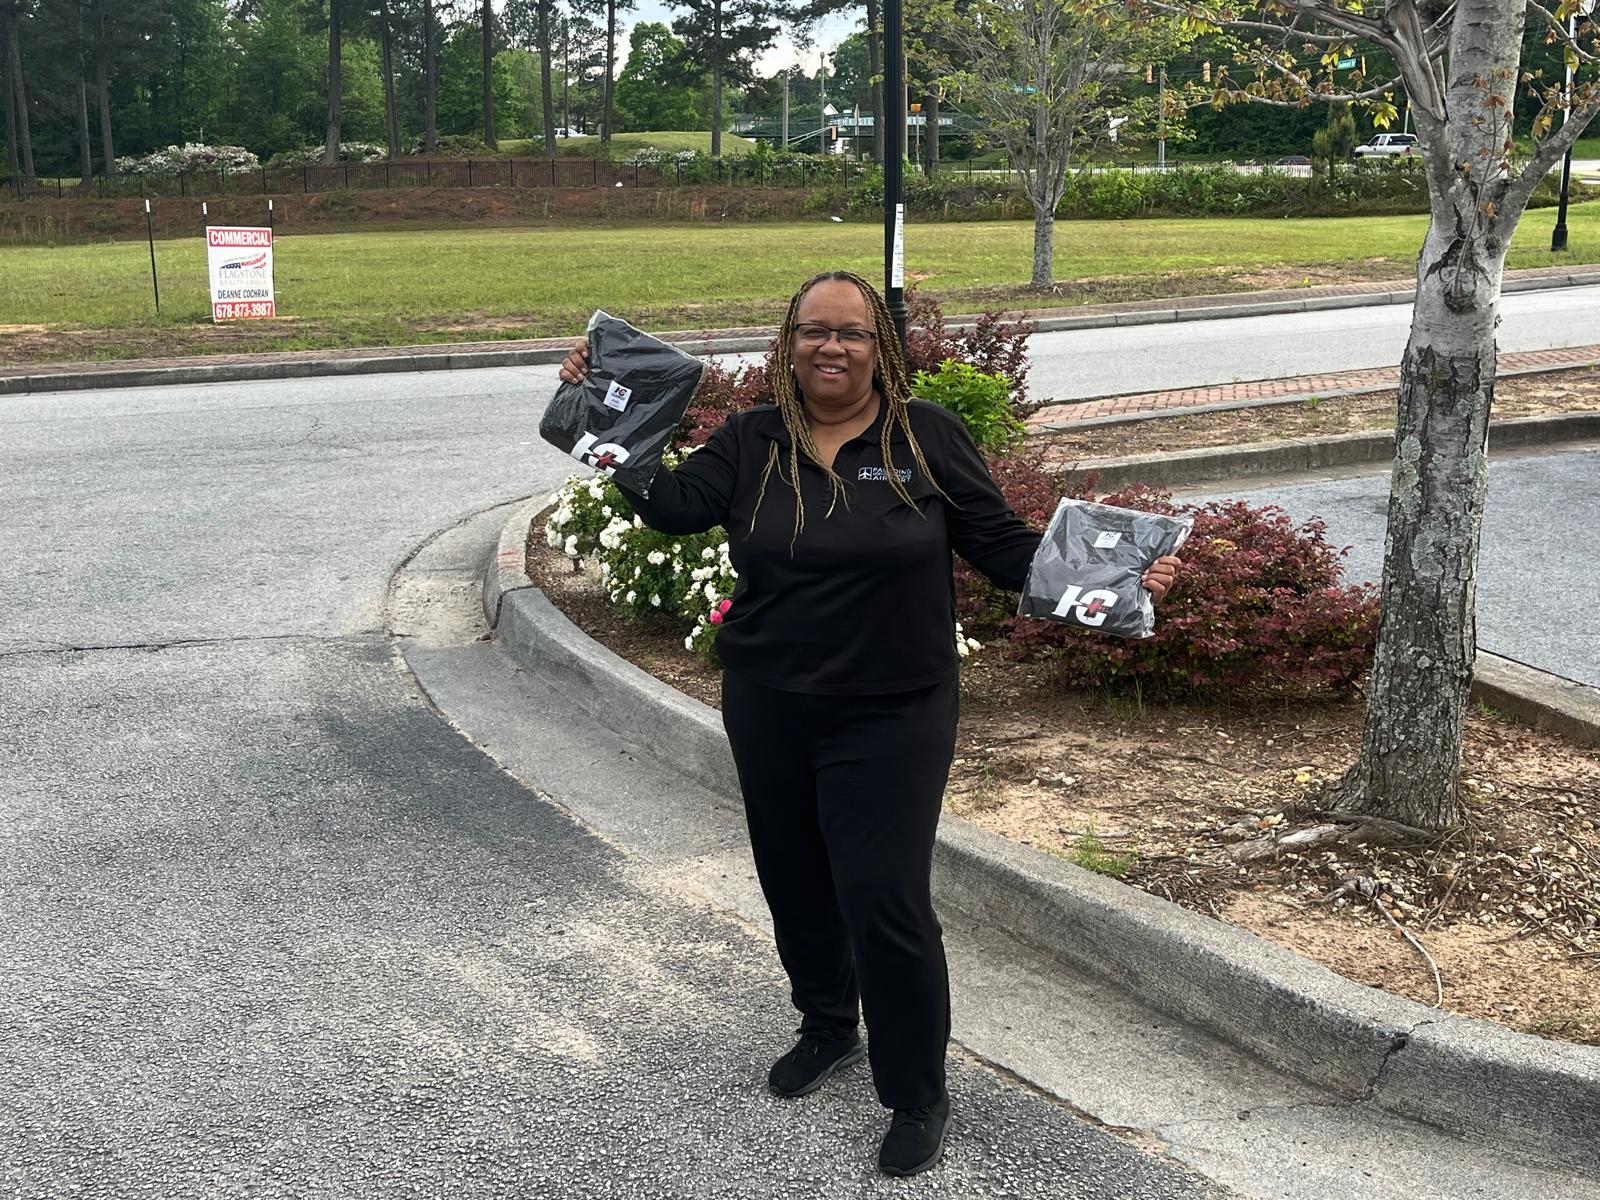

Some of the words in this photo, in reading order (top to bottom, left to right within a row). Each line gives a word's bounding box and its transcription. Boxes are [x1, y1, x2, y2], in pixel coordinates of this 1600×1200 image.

[210, 231, 270, 245] COMMERCIAL
[219, 269, 267, 279] FLAGSTONE
[218, 290, 241, 299] DEANNE
[243, 289, 269, 298] COCHRAN
[216, 303, 271, 318] 678-873-3987
